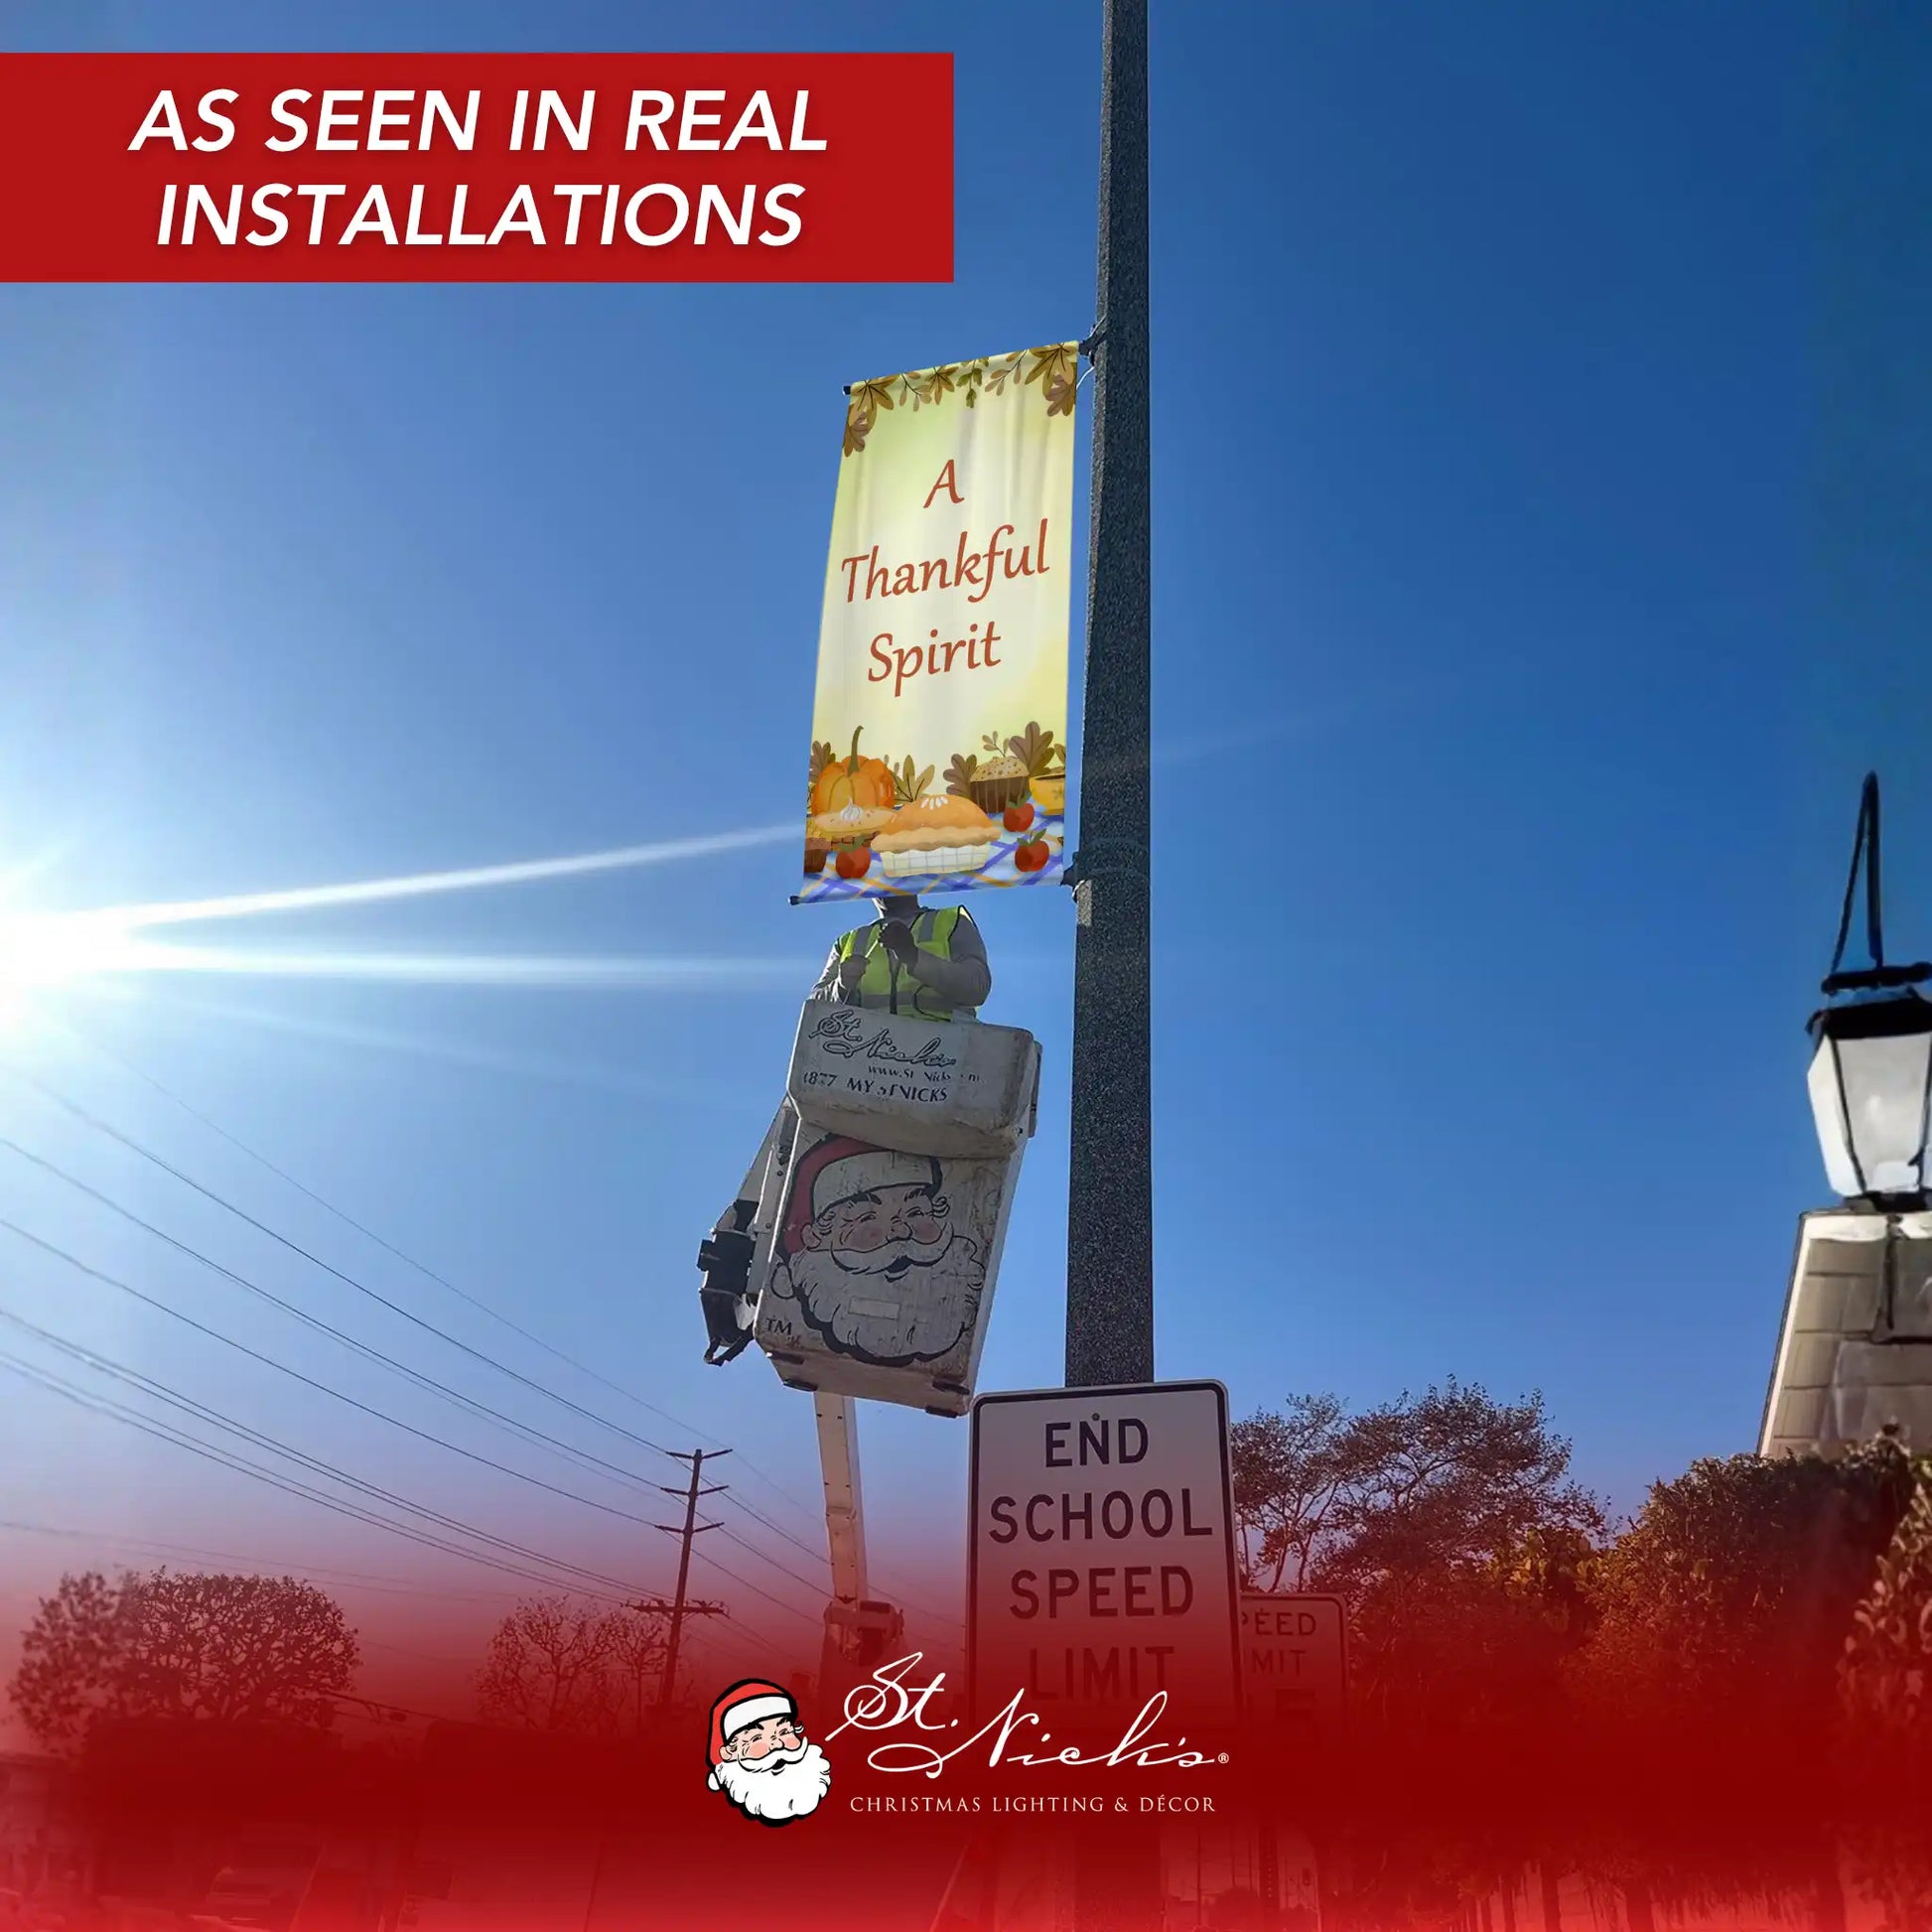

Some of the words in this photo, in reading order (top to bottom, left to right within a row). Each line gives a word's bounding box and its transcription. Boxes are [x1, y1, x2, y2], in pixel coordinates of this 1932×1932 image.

[922, 459, 965, 509] A
[841, 517, 1050, 604] Thankful
[867, 621, 1002, 698] Spirit
[846, 1077, 875, 1095] MY
[1044, 1418, 1149, 1467] END
[989, 1488, 1213, 1544] SCHOOL
[1009, 1566, 1193, 1619] SPEED
[1029, 1646, 1174, 1702] LIMIT
